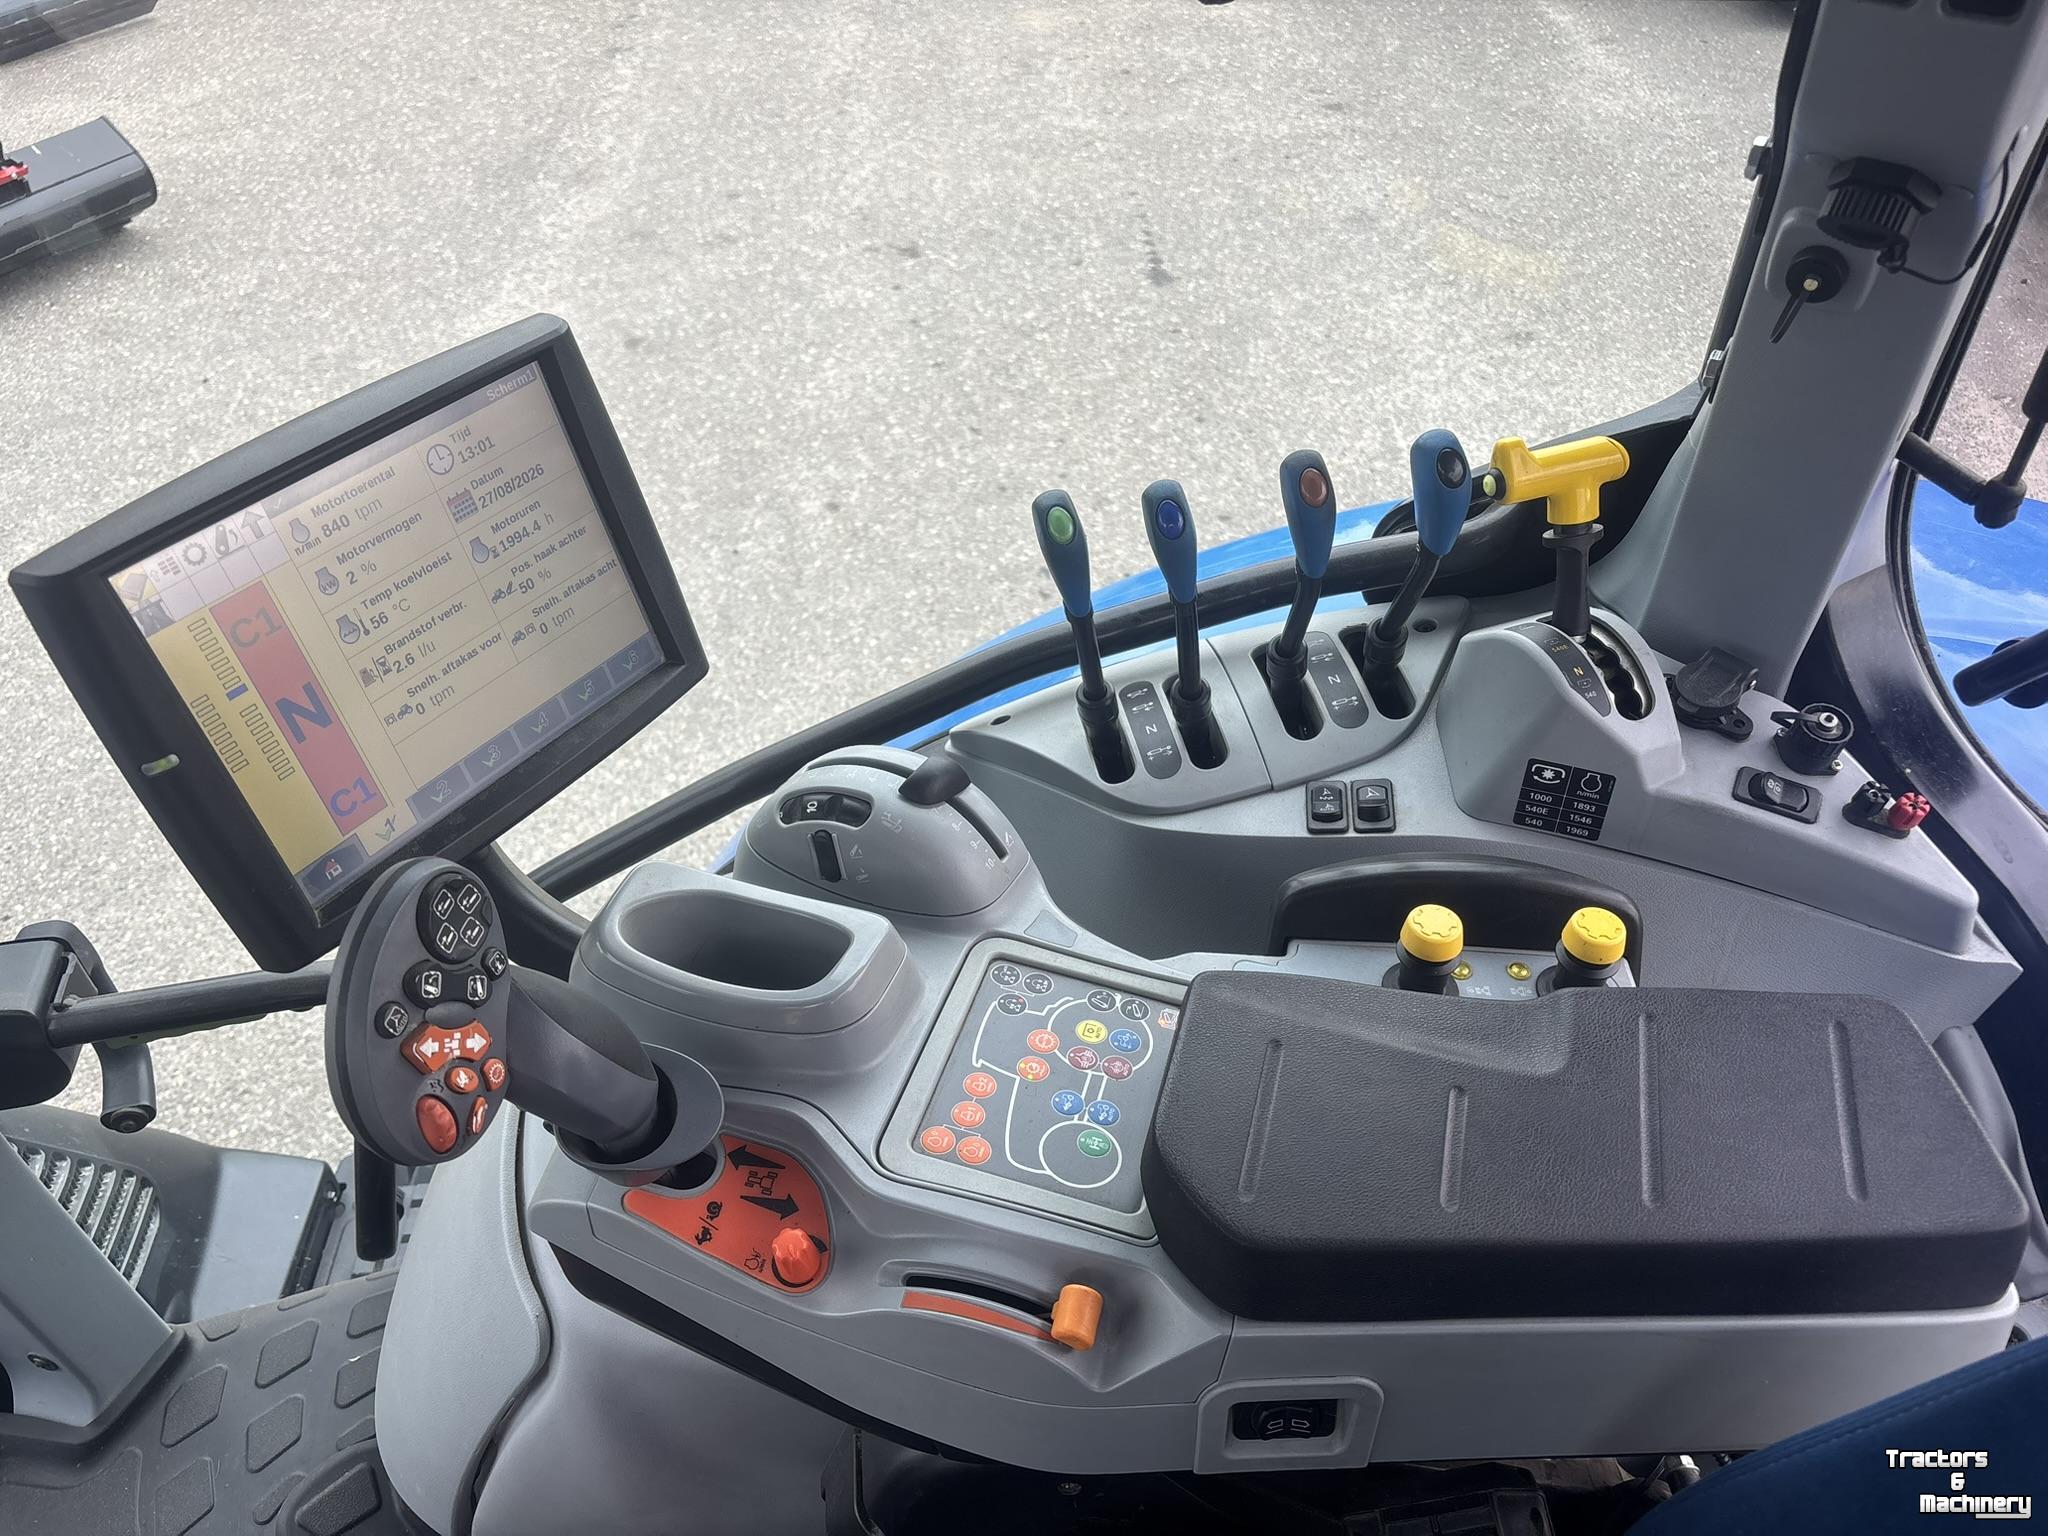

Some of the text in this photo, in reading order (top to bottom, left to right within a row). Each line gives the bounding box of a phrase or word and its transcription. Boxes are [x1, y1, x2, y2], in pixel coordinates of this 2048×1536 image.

[487, 368, 537, 401] Scherm1
[449, 426, 471, 444] Tijd
[458, 436, 495, 463] 13:01
[470, 466, 504, 490] Datum
[479, 464, 544, 509] 27/08/2026
[310, 466, 396, 518] Motortoerental
[321, 498, 383, 538] 840 tpm
[490, 500, 541, 534] Motoruren
[336, 512, 423, 566] Motorvermogen
[499, 512, 554, 552] 1994.4 h
[295, 536, 322, 556] n/min
[511, 526, 587, 577] Pos. haak achter
[346, 560, 377, 585] 2 %
[361, 551, 453, 610] Temp koelvloeist
[519, 568, 552, 595] 50 %
[320, 580, 337, 593] kW
[532, 559, 617, 618] Snelh. aftakas acht
[230, 606, 283, 648] C1
[369, 611, 389, 630] 56
[384, 600, 468, 655] Brandstof verbr.
[539, 607, 575, 635] 0 tpm
[392, 653, 416, 674] 2.6
[407, 632, 503, 698] Snelh. aftakas voor
[1573, 666, 1584, 676] N
[1327, 673, 1341, 685] N
[275, 681, 333, 744] N
[415, 685, 455, 715] 0 tpm
[1145, 723, 1158, 735] N
[330, 777, 377, 817] C1
[806, 801, 818, 814] 10
[1529, 792, 1553, 803] 1000
[1573, 801, 1596, 813] 1893
[1576, 790, 1600, 800] n/min
[1525, 804, 1549, 816] 540E
[1525, 817, 1543, 827] 540
[1570, 814, 1593, 825] 1546
[1566, 826, 1589, 837] 1969
[985, 858, 995, 870] 10
